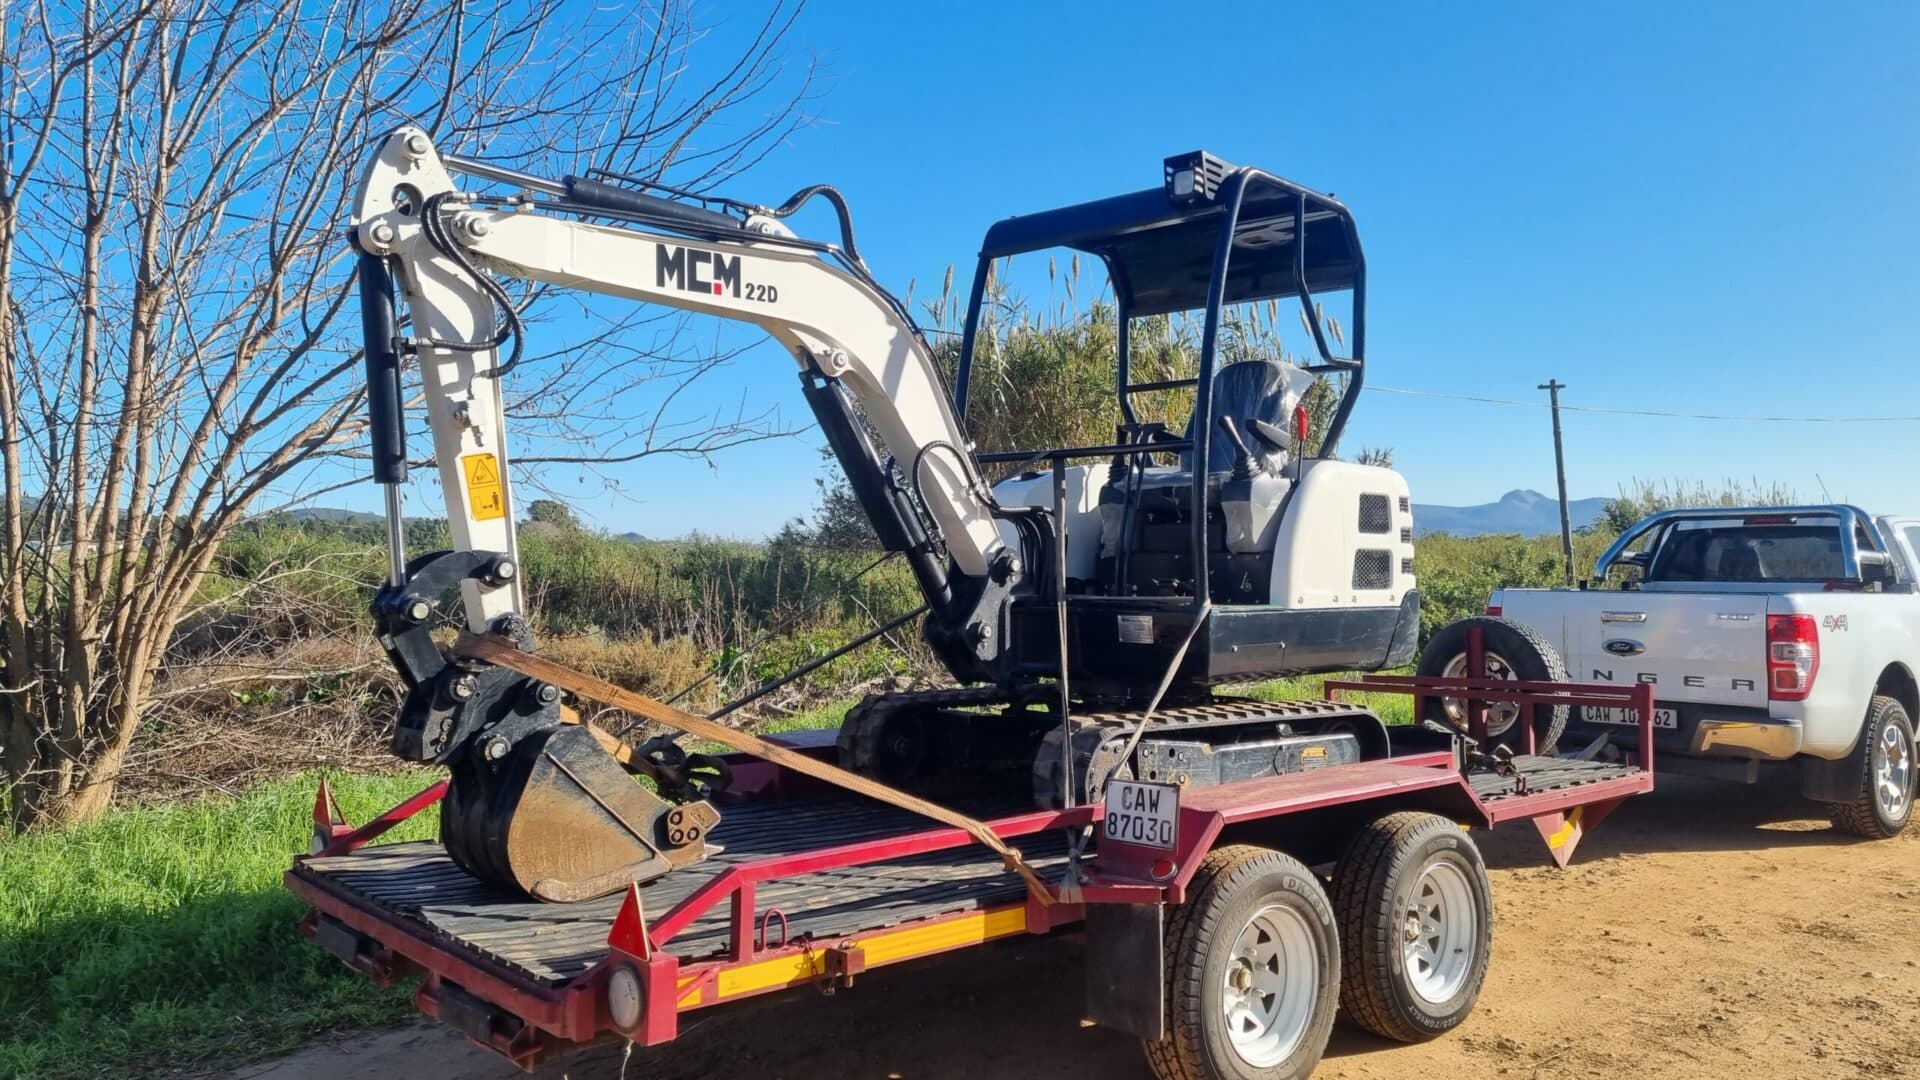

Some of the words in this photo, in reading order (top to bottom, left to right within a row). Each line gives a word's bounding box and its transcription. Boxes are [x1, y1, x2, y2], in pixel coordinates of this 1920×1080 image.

[656, 243, 741, 298] MCM
[745, 283, 778, 303] 22D
[1586, 706, 1610, 721] CAW
[1122, 786, 1160, 813] CAW
[1108, 812, 1172, 844] 87030
